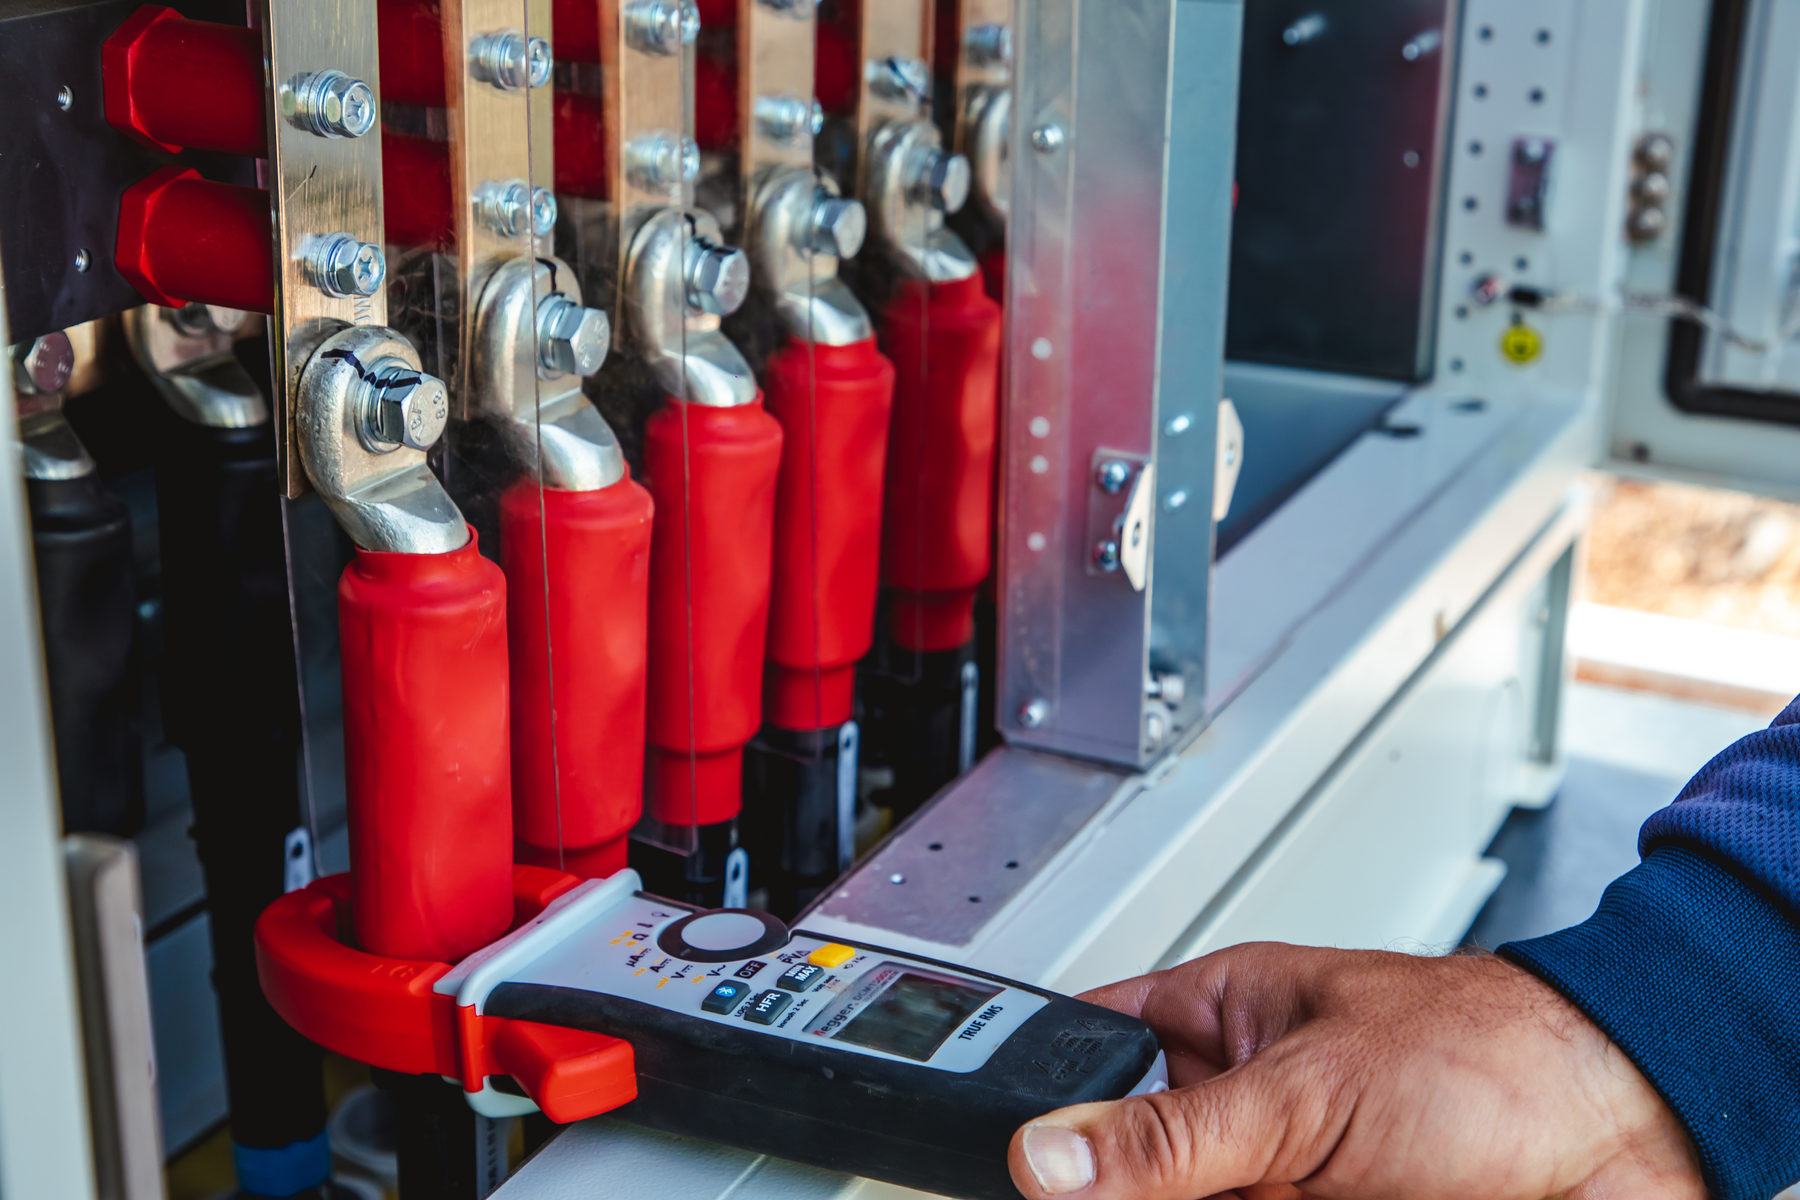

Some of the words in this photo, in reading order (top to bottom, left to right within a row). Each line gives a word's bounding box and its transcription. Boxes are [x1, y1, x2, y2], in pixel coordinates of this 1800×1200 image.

[738, 960, 761, 977] OFF
[795, 966, 819, 982] MAX
[756, 993, 781, 1013] HFR
[958, 1020, 987, 1041] TRUE
[979, 1005, 1004, 1021] RMS
